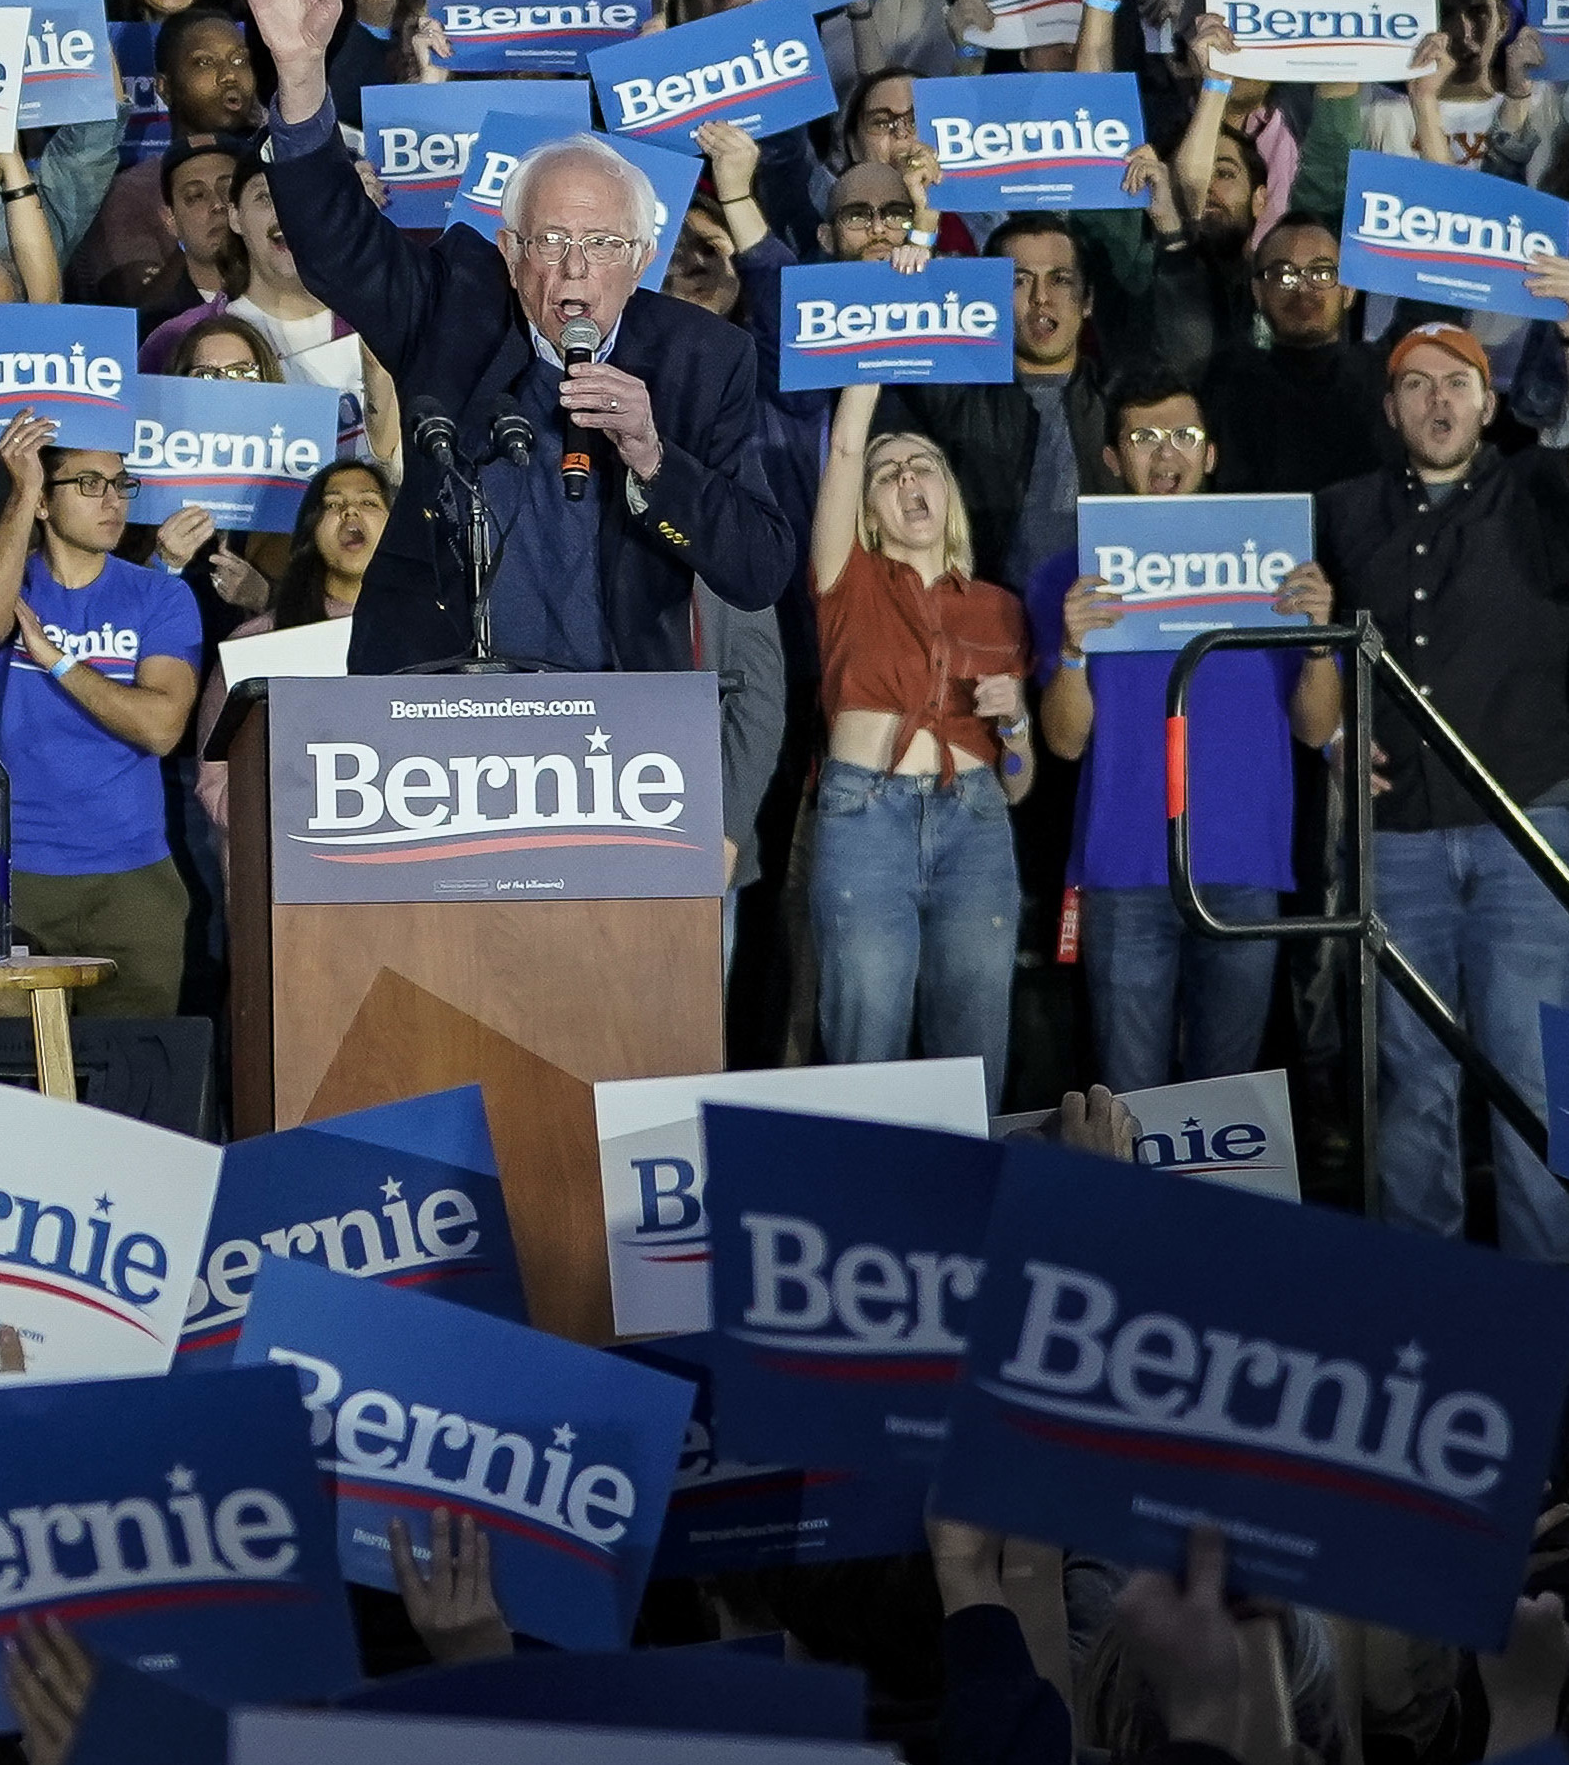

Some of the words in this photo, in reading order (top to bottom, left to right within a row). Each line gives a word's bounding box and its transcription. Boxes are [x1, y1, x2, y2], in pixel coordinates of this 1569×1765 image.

[1223, 2, 1418, 39] Bernie
[612, 38, 811, 127] Bernie
[379, 127, 480, 172] Ber
[931, 106, 1129, 163] Bernie
[796, 290, 998, 339] Bernie
[128, 423, 321, 478] Bernie
[390, 698, 595, 719] BernieSanders.com
[306, 725, 685, 829] Bernie
[1132, 1116, 1269, 1167] nie
[182, 1175, 480, 1315] ernie
[741, 1210, 987, 1355] Ber
[1001, 1259, 1514, 1499] Bernie
